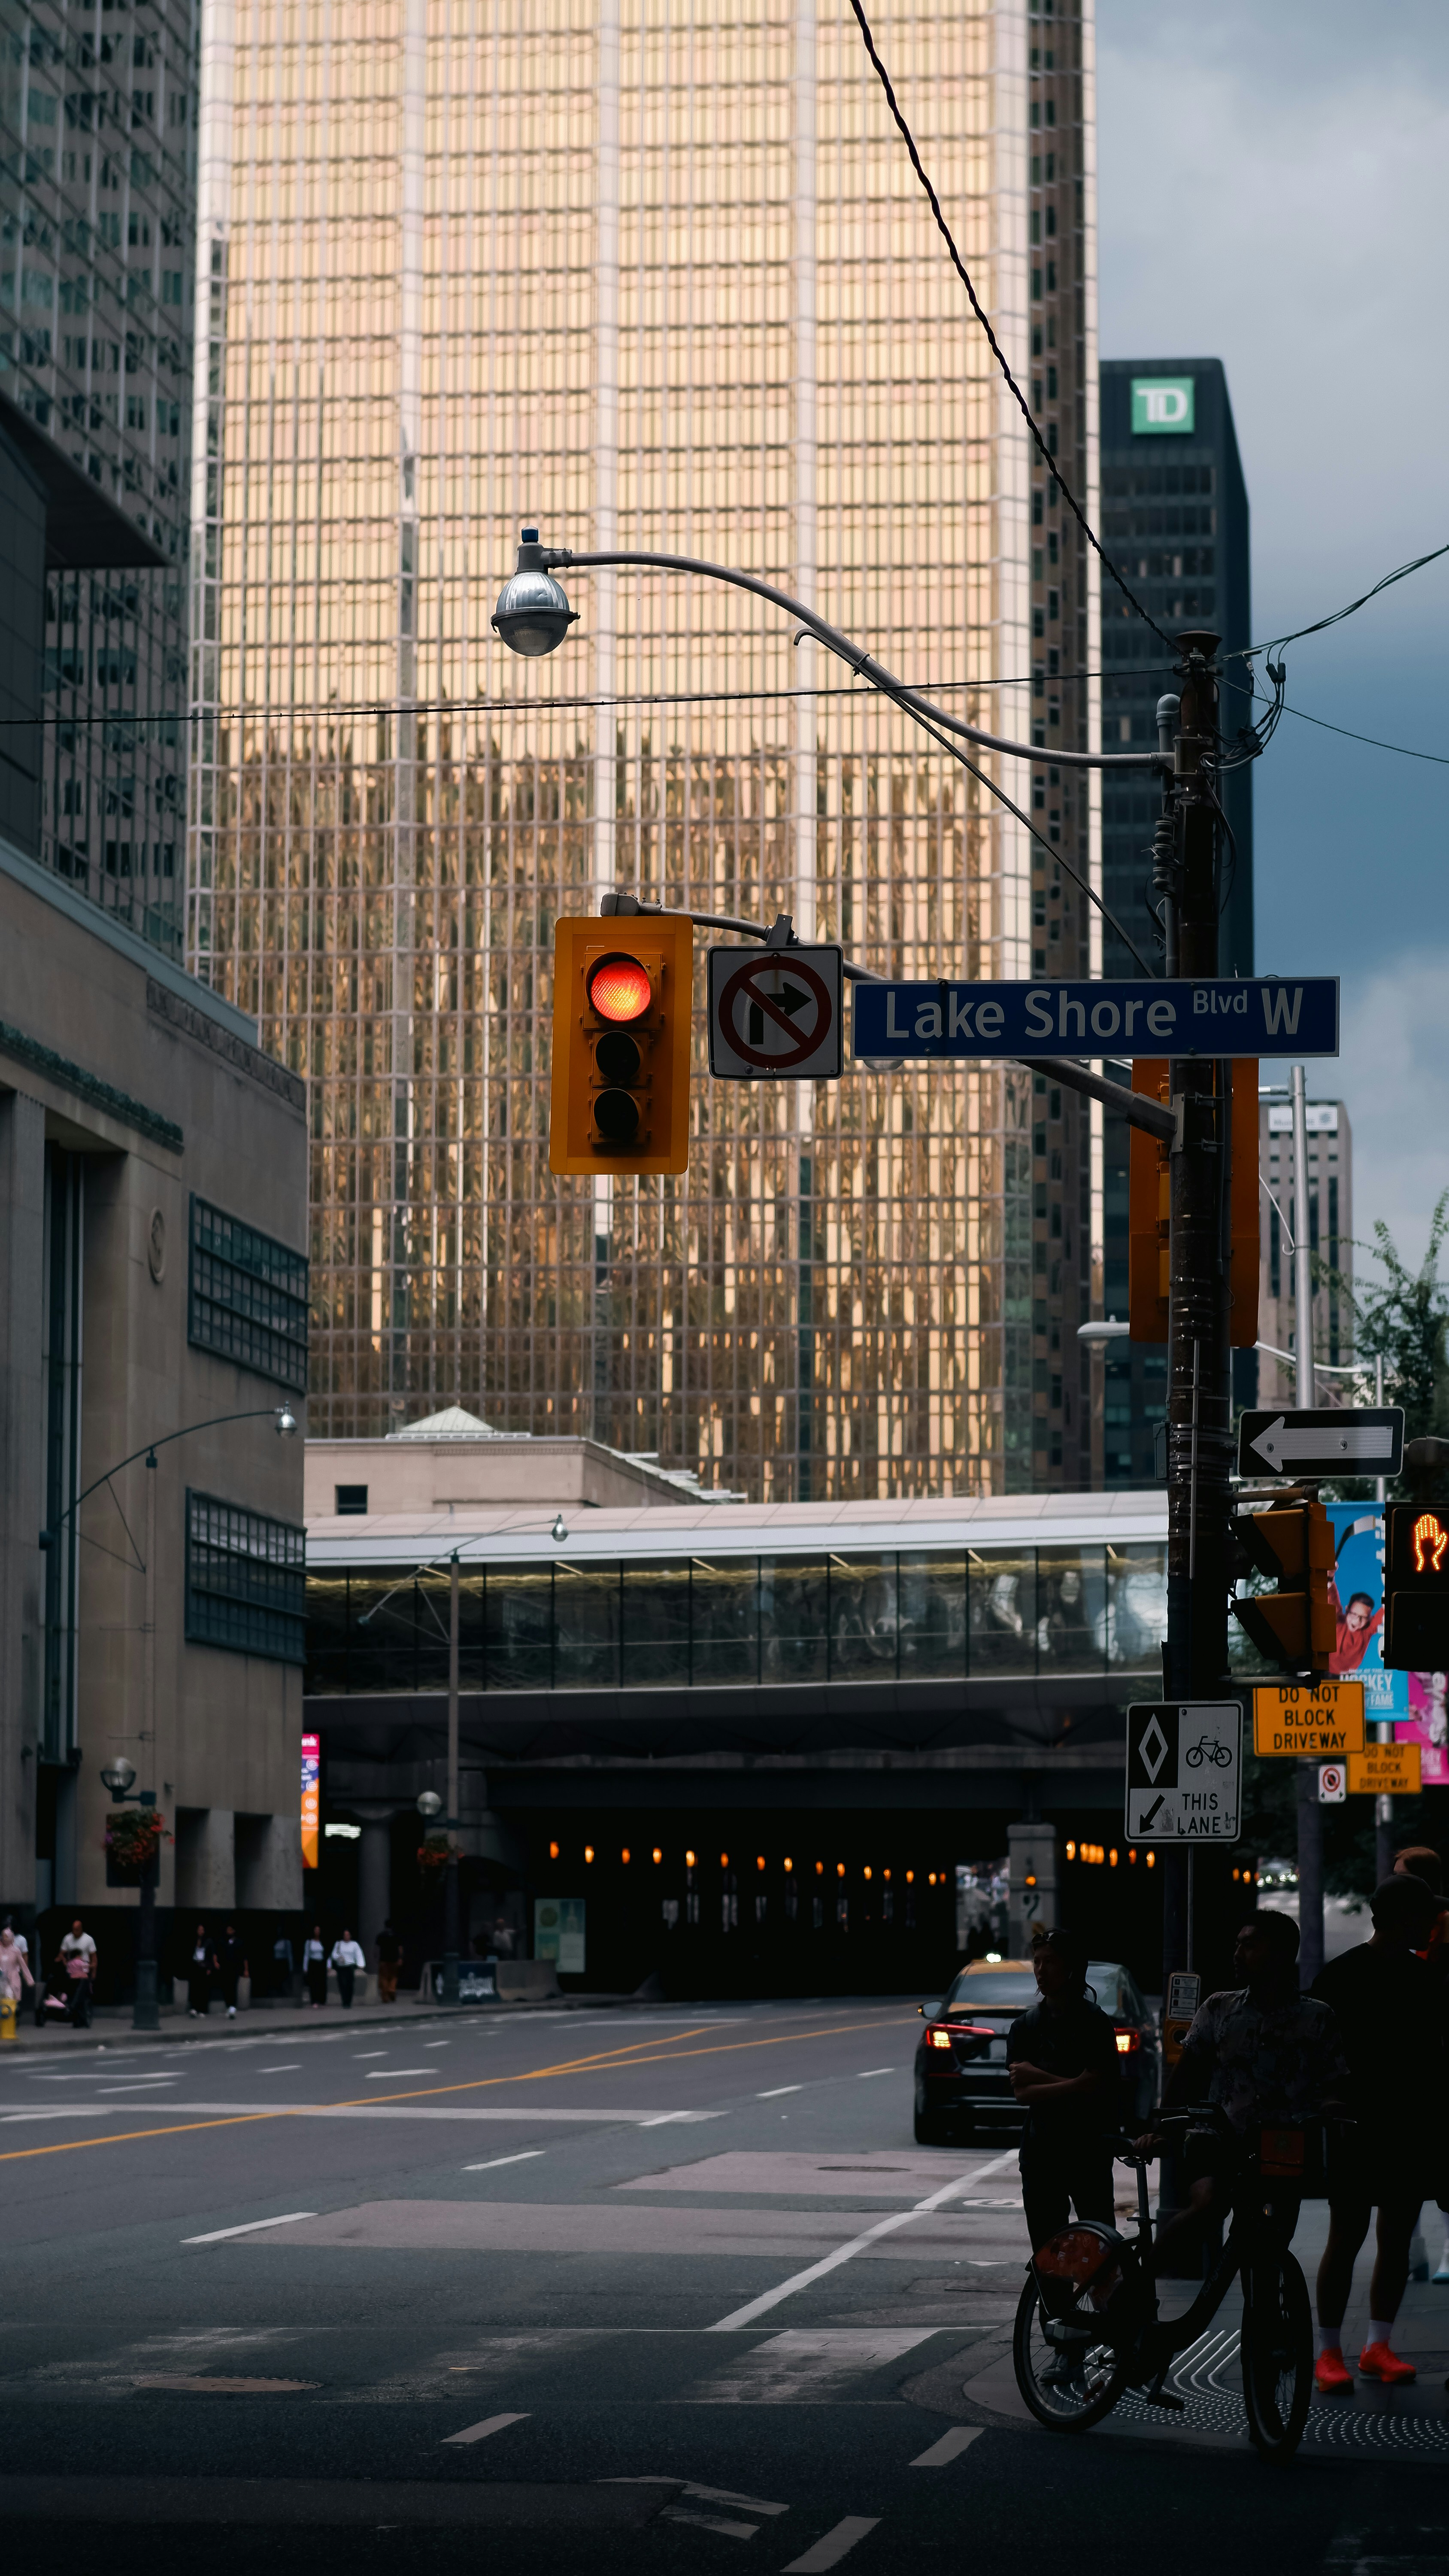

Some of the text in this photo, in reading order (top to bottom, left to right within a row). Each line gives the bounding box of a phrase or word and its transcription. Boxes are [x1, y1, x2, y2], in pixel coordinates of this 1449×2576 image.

[1137, 389, 1187, 422] TD
[886, 987, 1303, 1039] Lake Shore Blvd W
[1279, 1686, 1340, 1703] DO NOT
[1284, 1709, 1335, 1726] BLOCK
[1273, 1732, 1346, 1750] DRIVEWAY
[1364, 1746, 1404, 1758] DO NOT
[1367, 1762, 1401, 1773] BLOCK
[1360, 1778, 1409, 1789] DRIVEWAY
[1182, 1793, 1219, 1810] THIS
[1177, 1817, 1221, 1834] LANE
